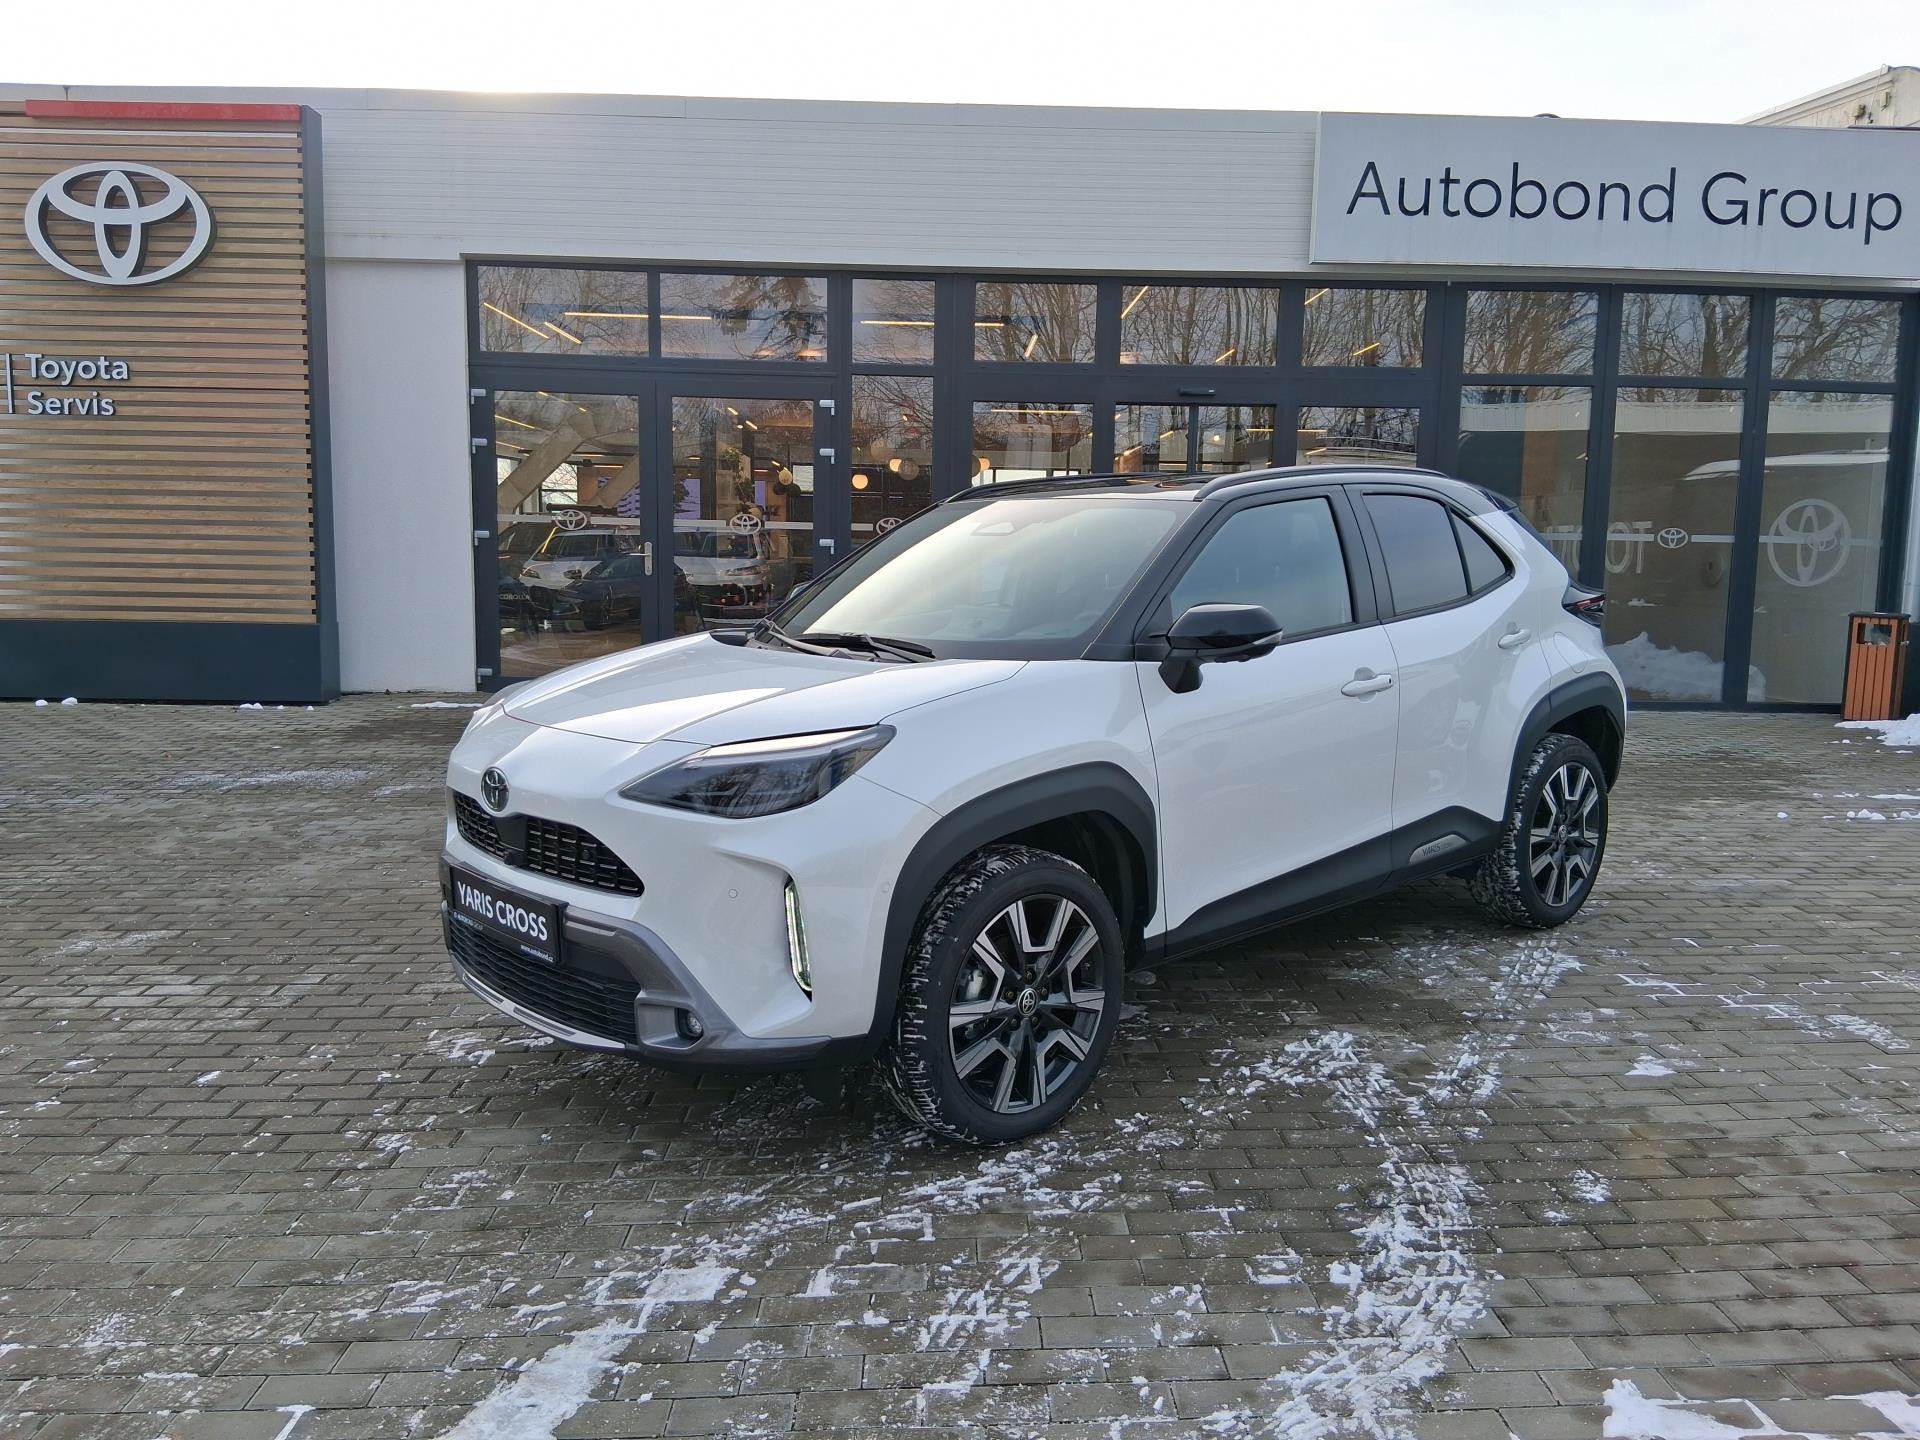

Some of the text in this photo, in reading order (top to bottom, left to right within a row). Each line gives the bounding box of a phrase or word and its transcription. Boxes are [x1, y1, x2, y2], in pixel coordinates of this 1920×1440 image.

[1346, 161, 1903, 245] Autobond Group
[25, 353, 129, 386] Toyota
[27, 391, 115, 416] Servis
[458, 881, 494, 919] YARIS
[496, 900, 548, 941] CROSS
